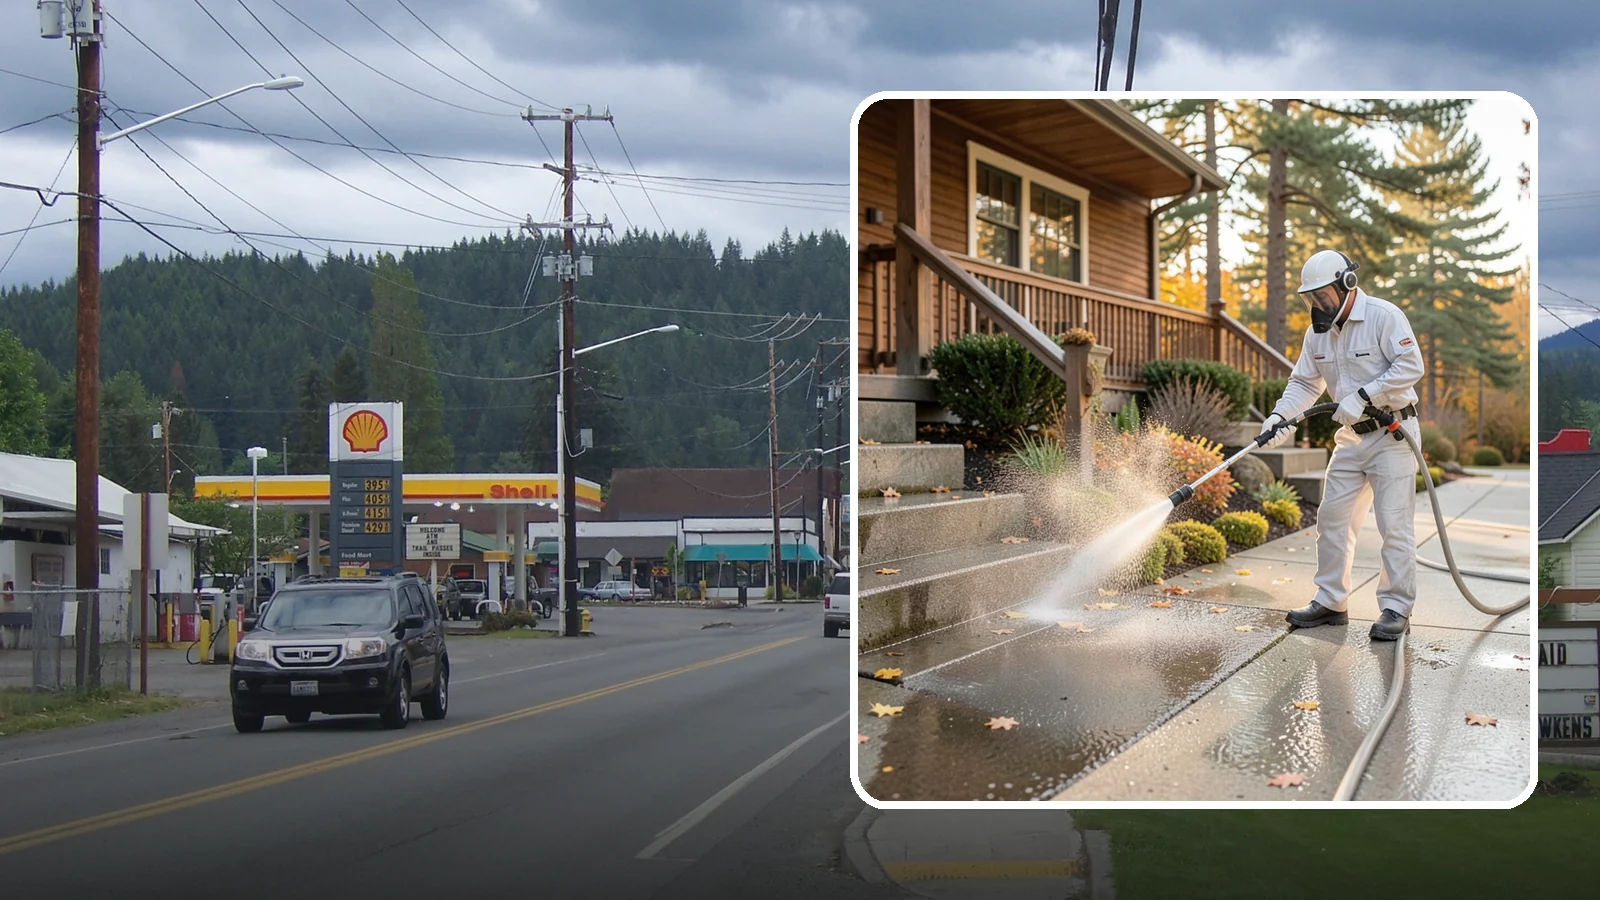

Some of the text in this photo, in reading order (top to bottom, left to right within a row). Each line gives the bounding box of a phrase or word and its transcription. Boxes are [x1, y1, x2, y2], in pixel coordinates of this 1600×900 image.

[366, 480, 383, 490] 395
[490, 484, 547, 499] Shell
[366, 494, 383, 504] 405
[366, 508, 383, 518] 415
[366, 522, 383, 532] 429
